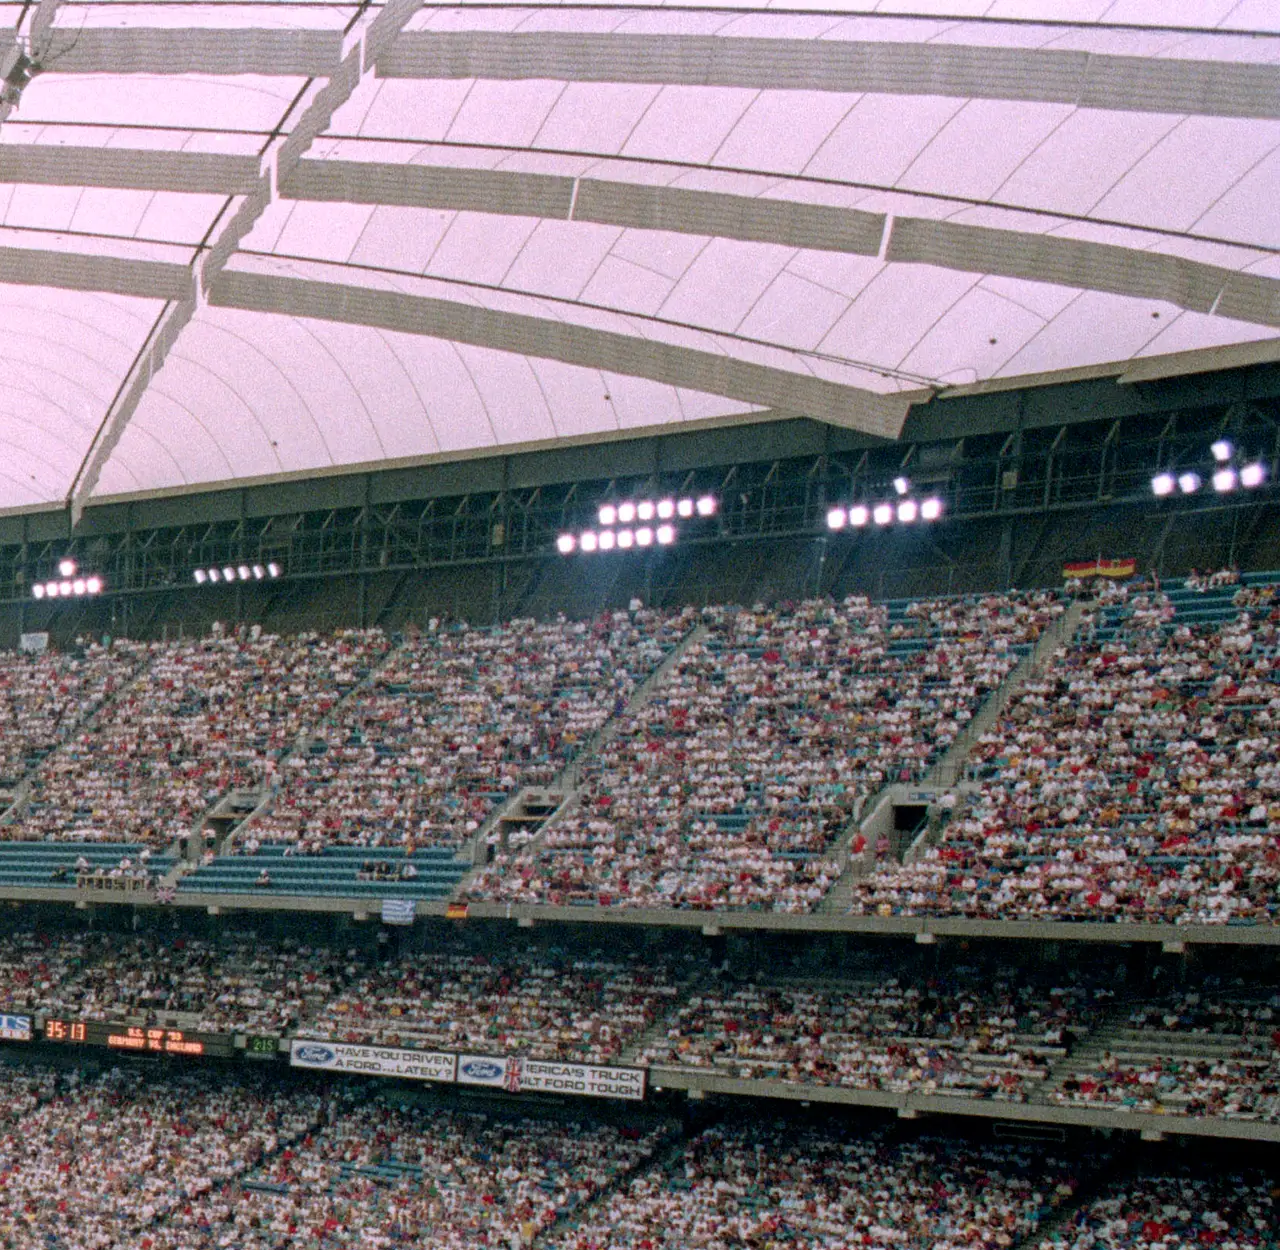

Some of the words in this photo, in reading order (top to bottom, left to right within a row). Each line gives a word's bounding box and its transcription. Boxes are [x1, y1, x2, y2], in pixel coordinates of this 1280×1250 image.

[107, 1035, 145, 1048] GERMANY
[165, 1041, 204, 1054] ENGLAND
[300, 1046, 330, 1060] Ford
[335, 1046, 366, 1058] HAVE
[371, 1049, 401, 1060] YOU
[403, 1052, 453, 1066] DRIVEN
[335, 1059, 345, 1068] A
[470, 1061, 499, 1078] Ford
[590, 1069, 640, 1084] TRUCK
[544, 1079, 586, 1092] FORD
[588, 1081, 641, 1097] TOUGH
